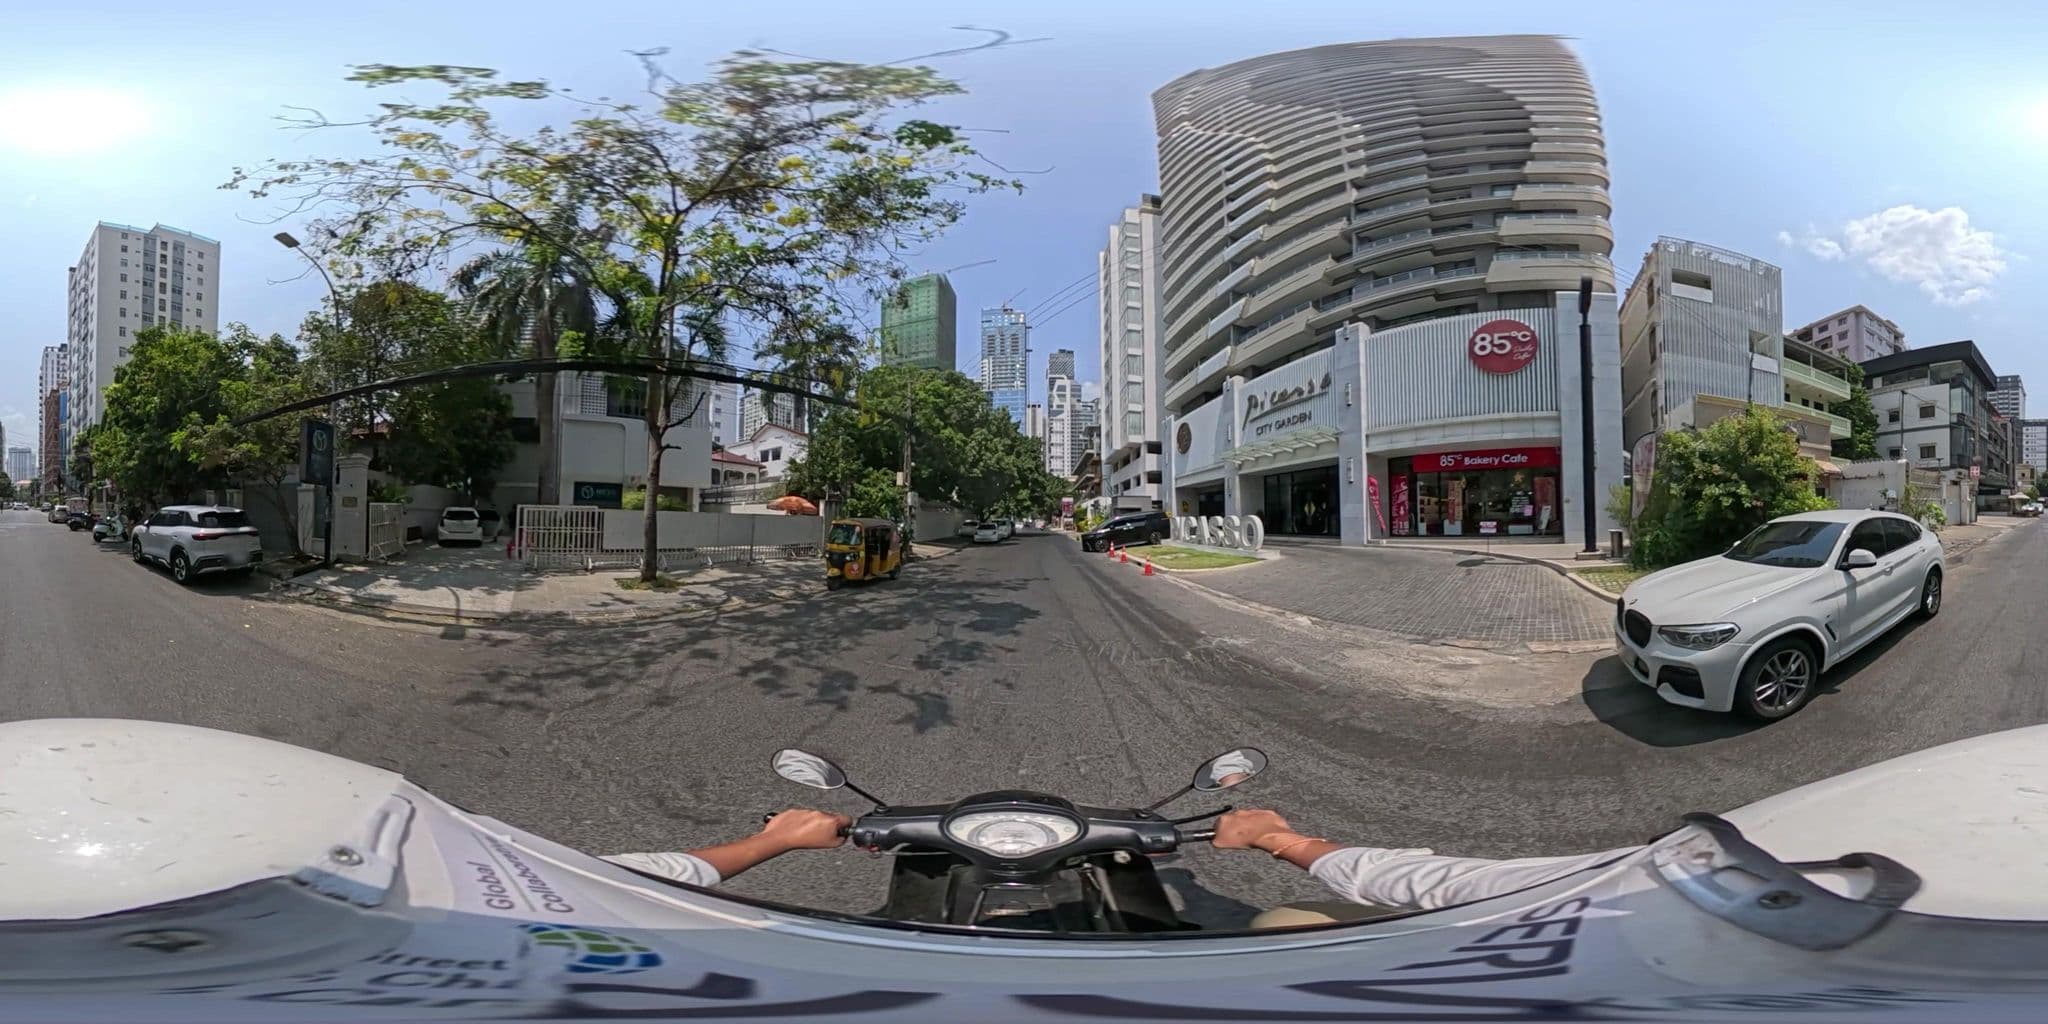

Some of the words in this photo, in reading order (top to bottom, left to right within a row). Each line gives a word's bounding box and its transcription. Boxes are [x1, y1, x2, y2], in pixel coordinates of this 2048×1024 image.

[1256, 421, 1273, 436] CITY
[1274, 410, 1312, 430] GARDEN
[1463, 455, 1501, 466] Bakery
[1501, 453, 1529, 464] Cafe
[466, 861, 515, 910] Global
